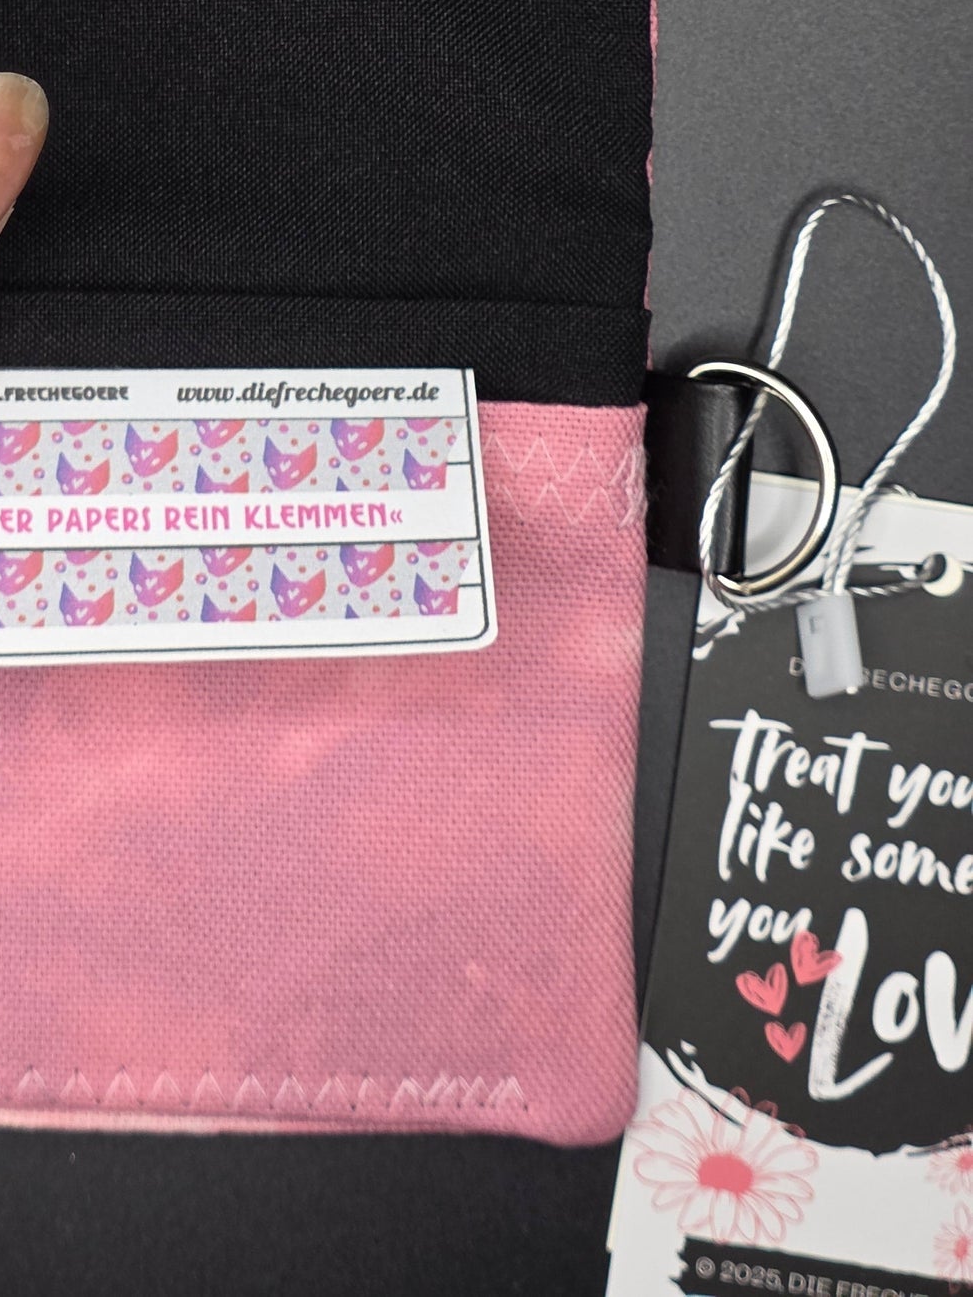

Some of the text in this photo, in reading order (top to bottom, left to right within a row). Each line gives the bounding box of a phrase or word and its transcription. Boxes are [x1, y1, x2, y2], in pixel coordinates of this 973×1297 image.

[176, 380, 441, 409] www.diefrechegoere.de
[47, 507, 151, 532] PAPERS
[164, 505, 230, 531] REIN
[718, 780, 815, 882] like
[707, 897, 813, 963] you
[788, 1271, 832, 1297] DIE
